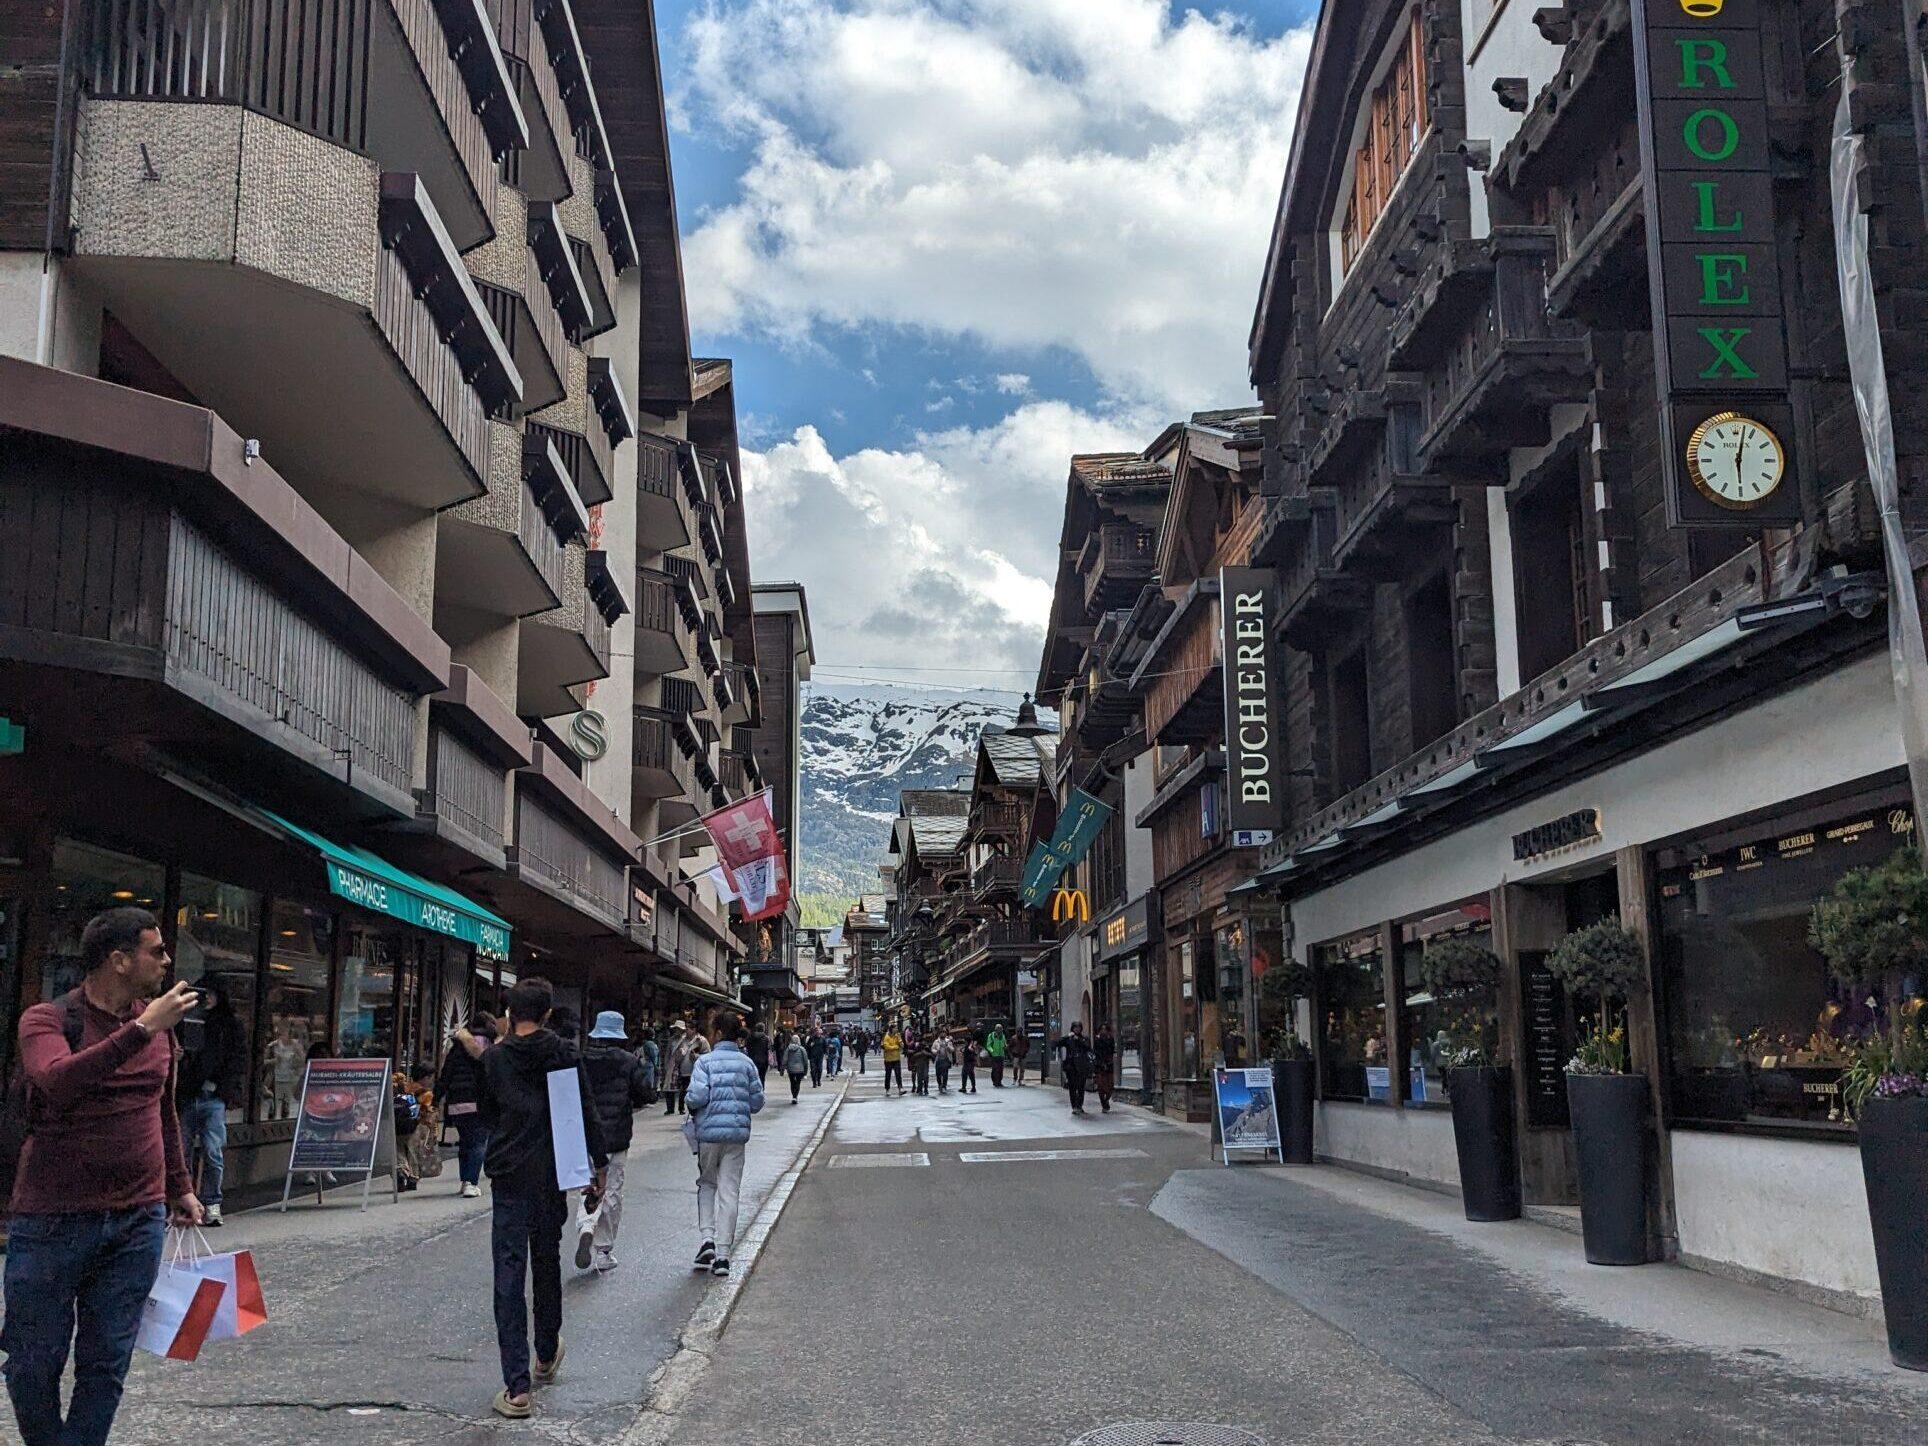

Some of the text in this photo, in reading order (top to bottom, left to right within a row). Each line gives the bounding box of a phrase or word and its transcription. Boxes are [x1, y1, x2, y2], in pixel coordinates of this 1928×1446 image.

[1674, 38, 1759, 381] ROLEX
[1235, 589, 1272, 804] BUCHERER
[1778, 832, 1815, 851] BUCHERER
[1739, 846, 1757, 862] IWC
[1803, 1083, 1839, 1094] BUCHERER
